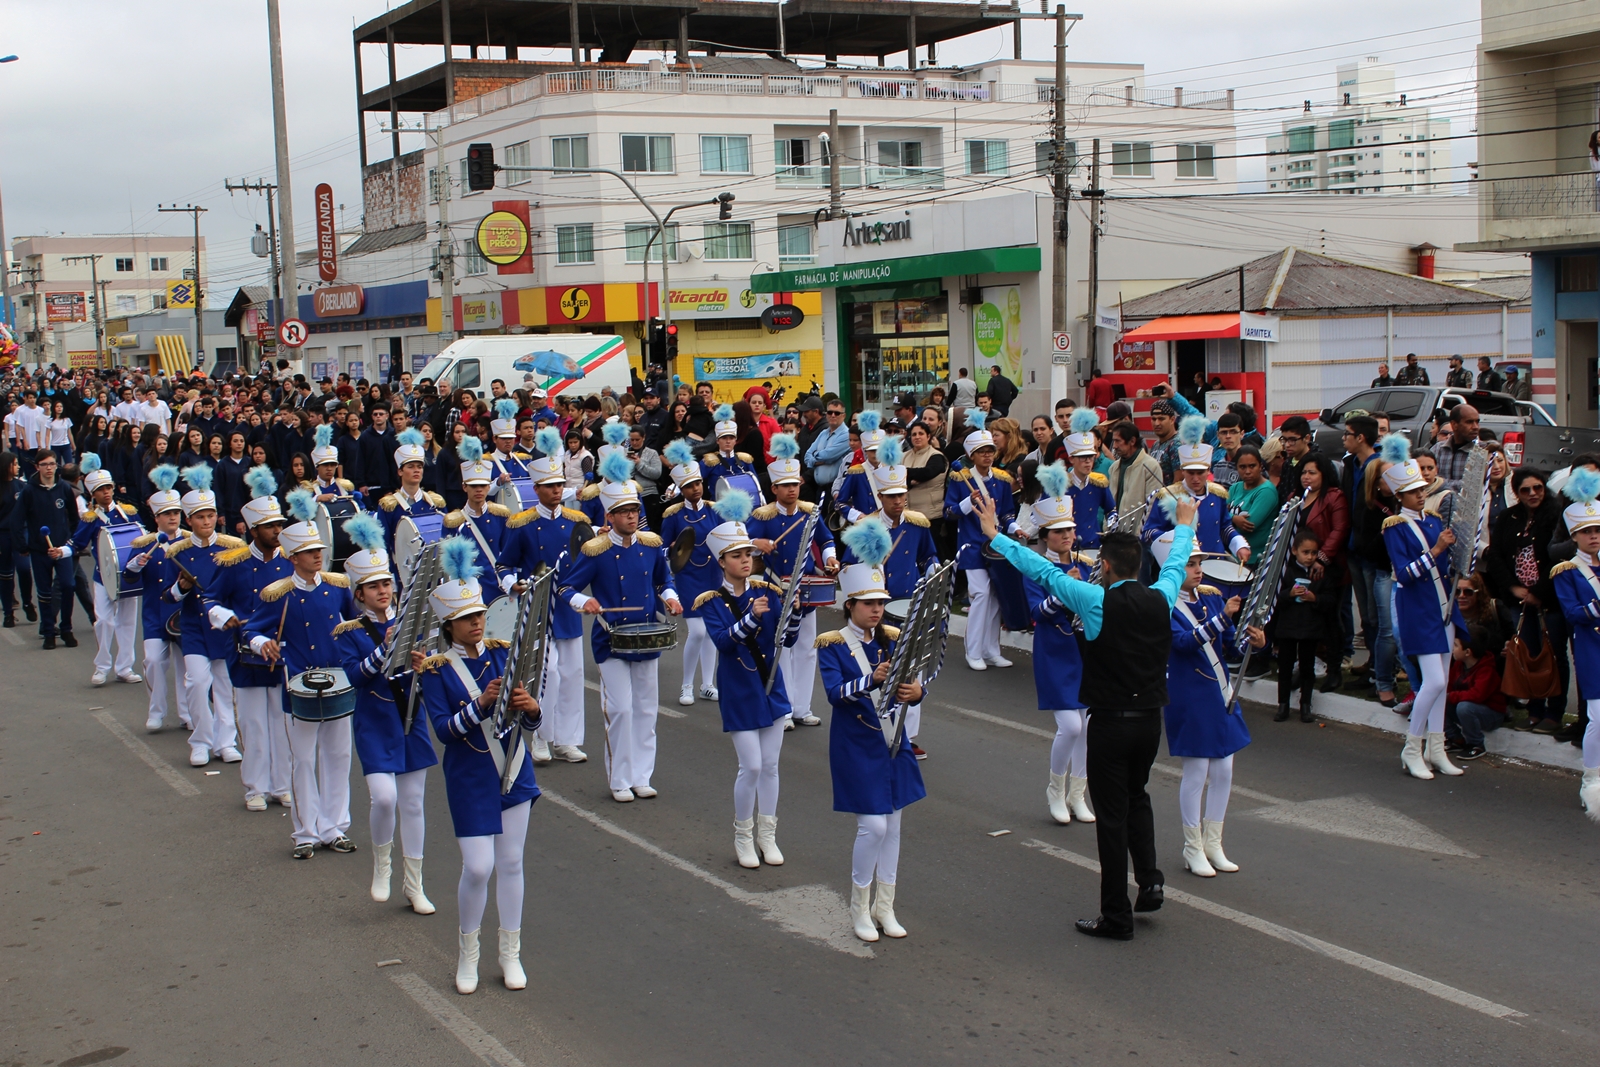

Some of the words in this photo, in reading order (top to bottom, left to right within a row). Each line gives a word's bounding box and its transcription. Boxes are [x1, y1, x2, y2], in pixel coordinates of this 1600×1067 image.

[319, 192, 333, 258] BERLANDA
[842, 210, 912, 247] Artesani
[491, 227, 515, 236] TUDO
[490, 238, 517, 248] PREÇO
[795, 271, 827, 285] FARMÁCIA
[829, 272, 839, 282] DE
[843, 264, 891, 280] MANIPULAÇÃO
[325, 292, 358, 311] BERLANDA
[663, 290, 728, 304] Ricardo
[464, 302, 486, 315] Ricardo
[698, 304, 724, 312] eletro
[978, 310, 987, 321] Na
[977, 318, 1001, 330] medida
[978, 329, 995, 339] certa
[1060, 337, 1066, 347] E
[715, 357, 748, 366] CRÉDITO
[716, 365, 750, 374] PESSOAL
